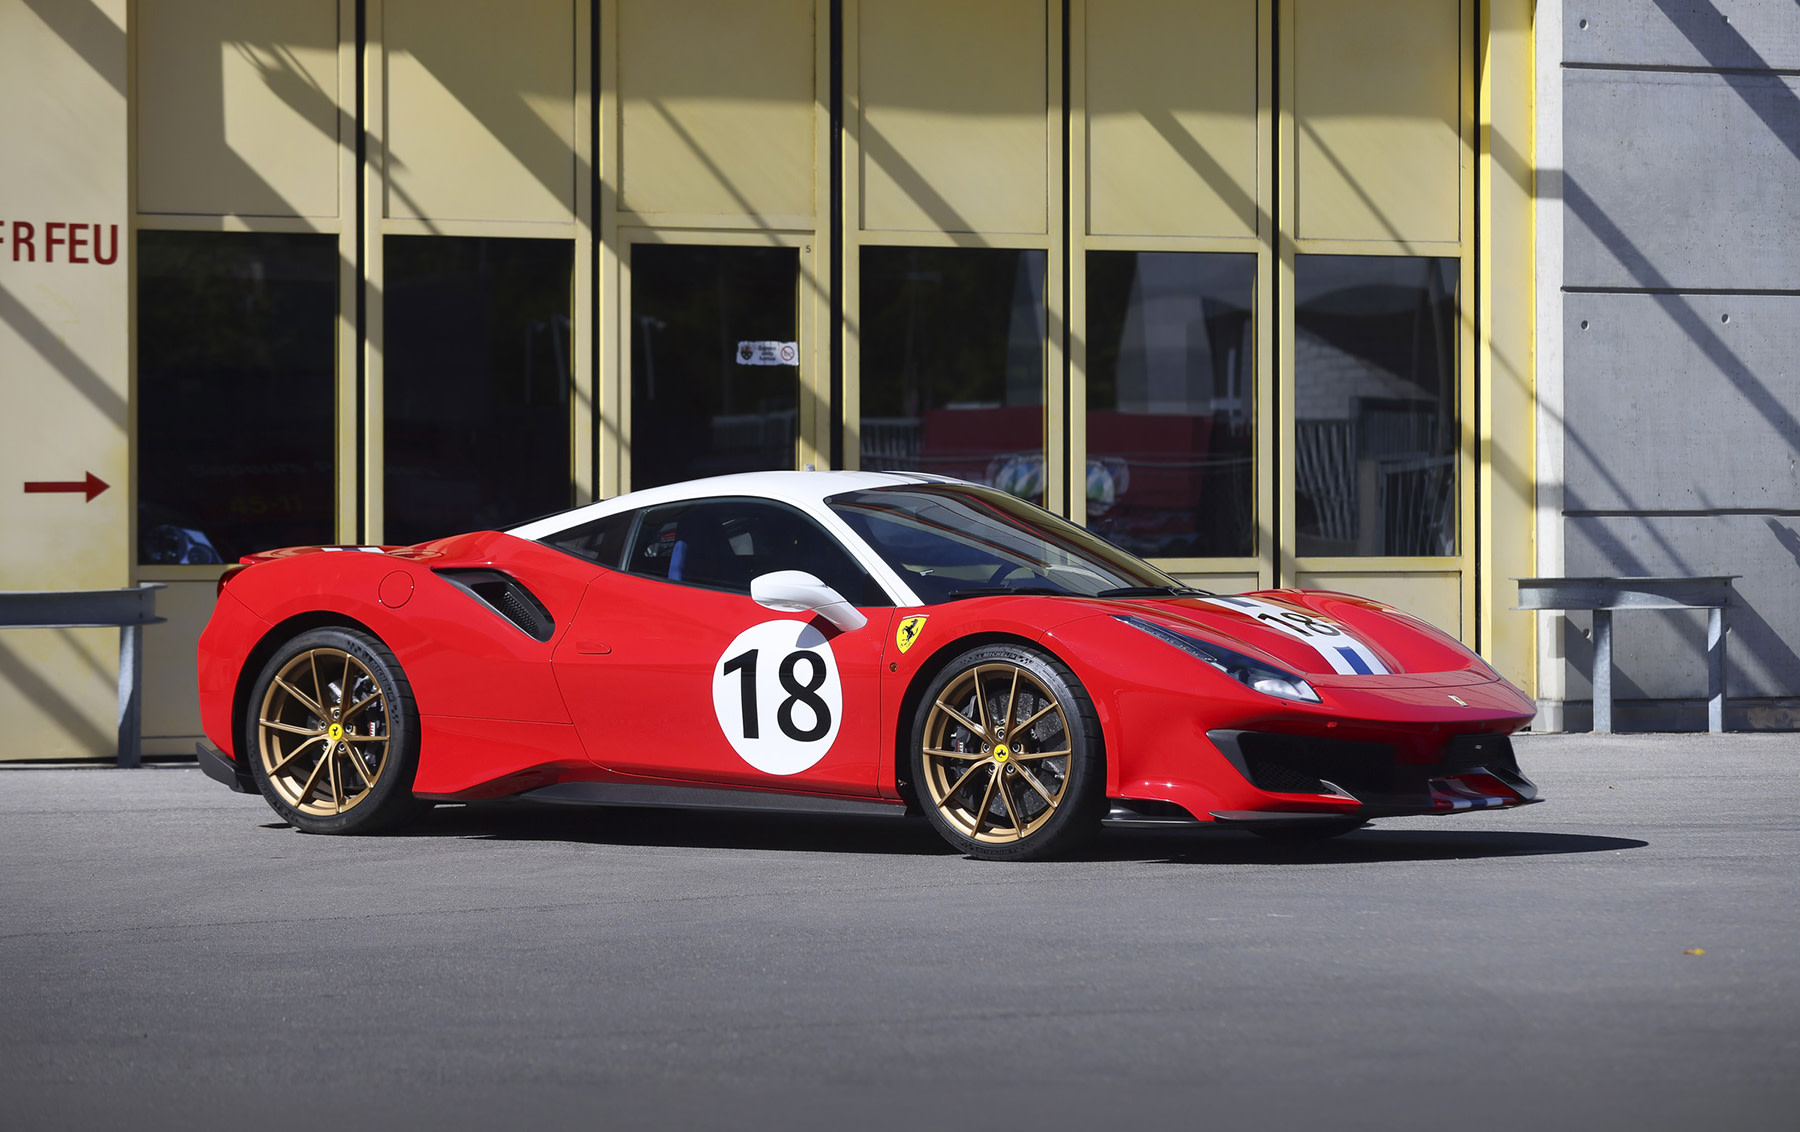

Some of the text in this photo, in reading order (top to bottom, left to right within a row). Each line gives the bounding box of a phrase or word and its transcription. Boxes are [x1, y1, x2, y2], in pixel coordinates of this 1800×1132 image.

[0, 220, 119, 265] R FEU
[805, 244, 812, 254] 5
[1257, 612, 1341, 637] 18
[723, 649, 832, 743] 18
